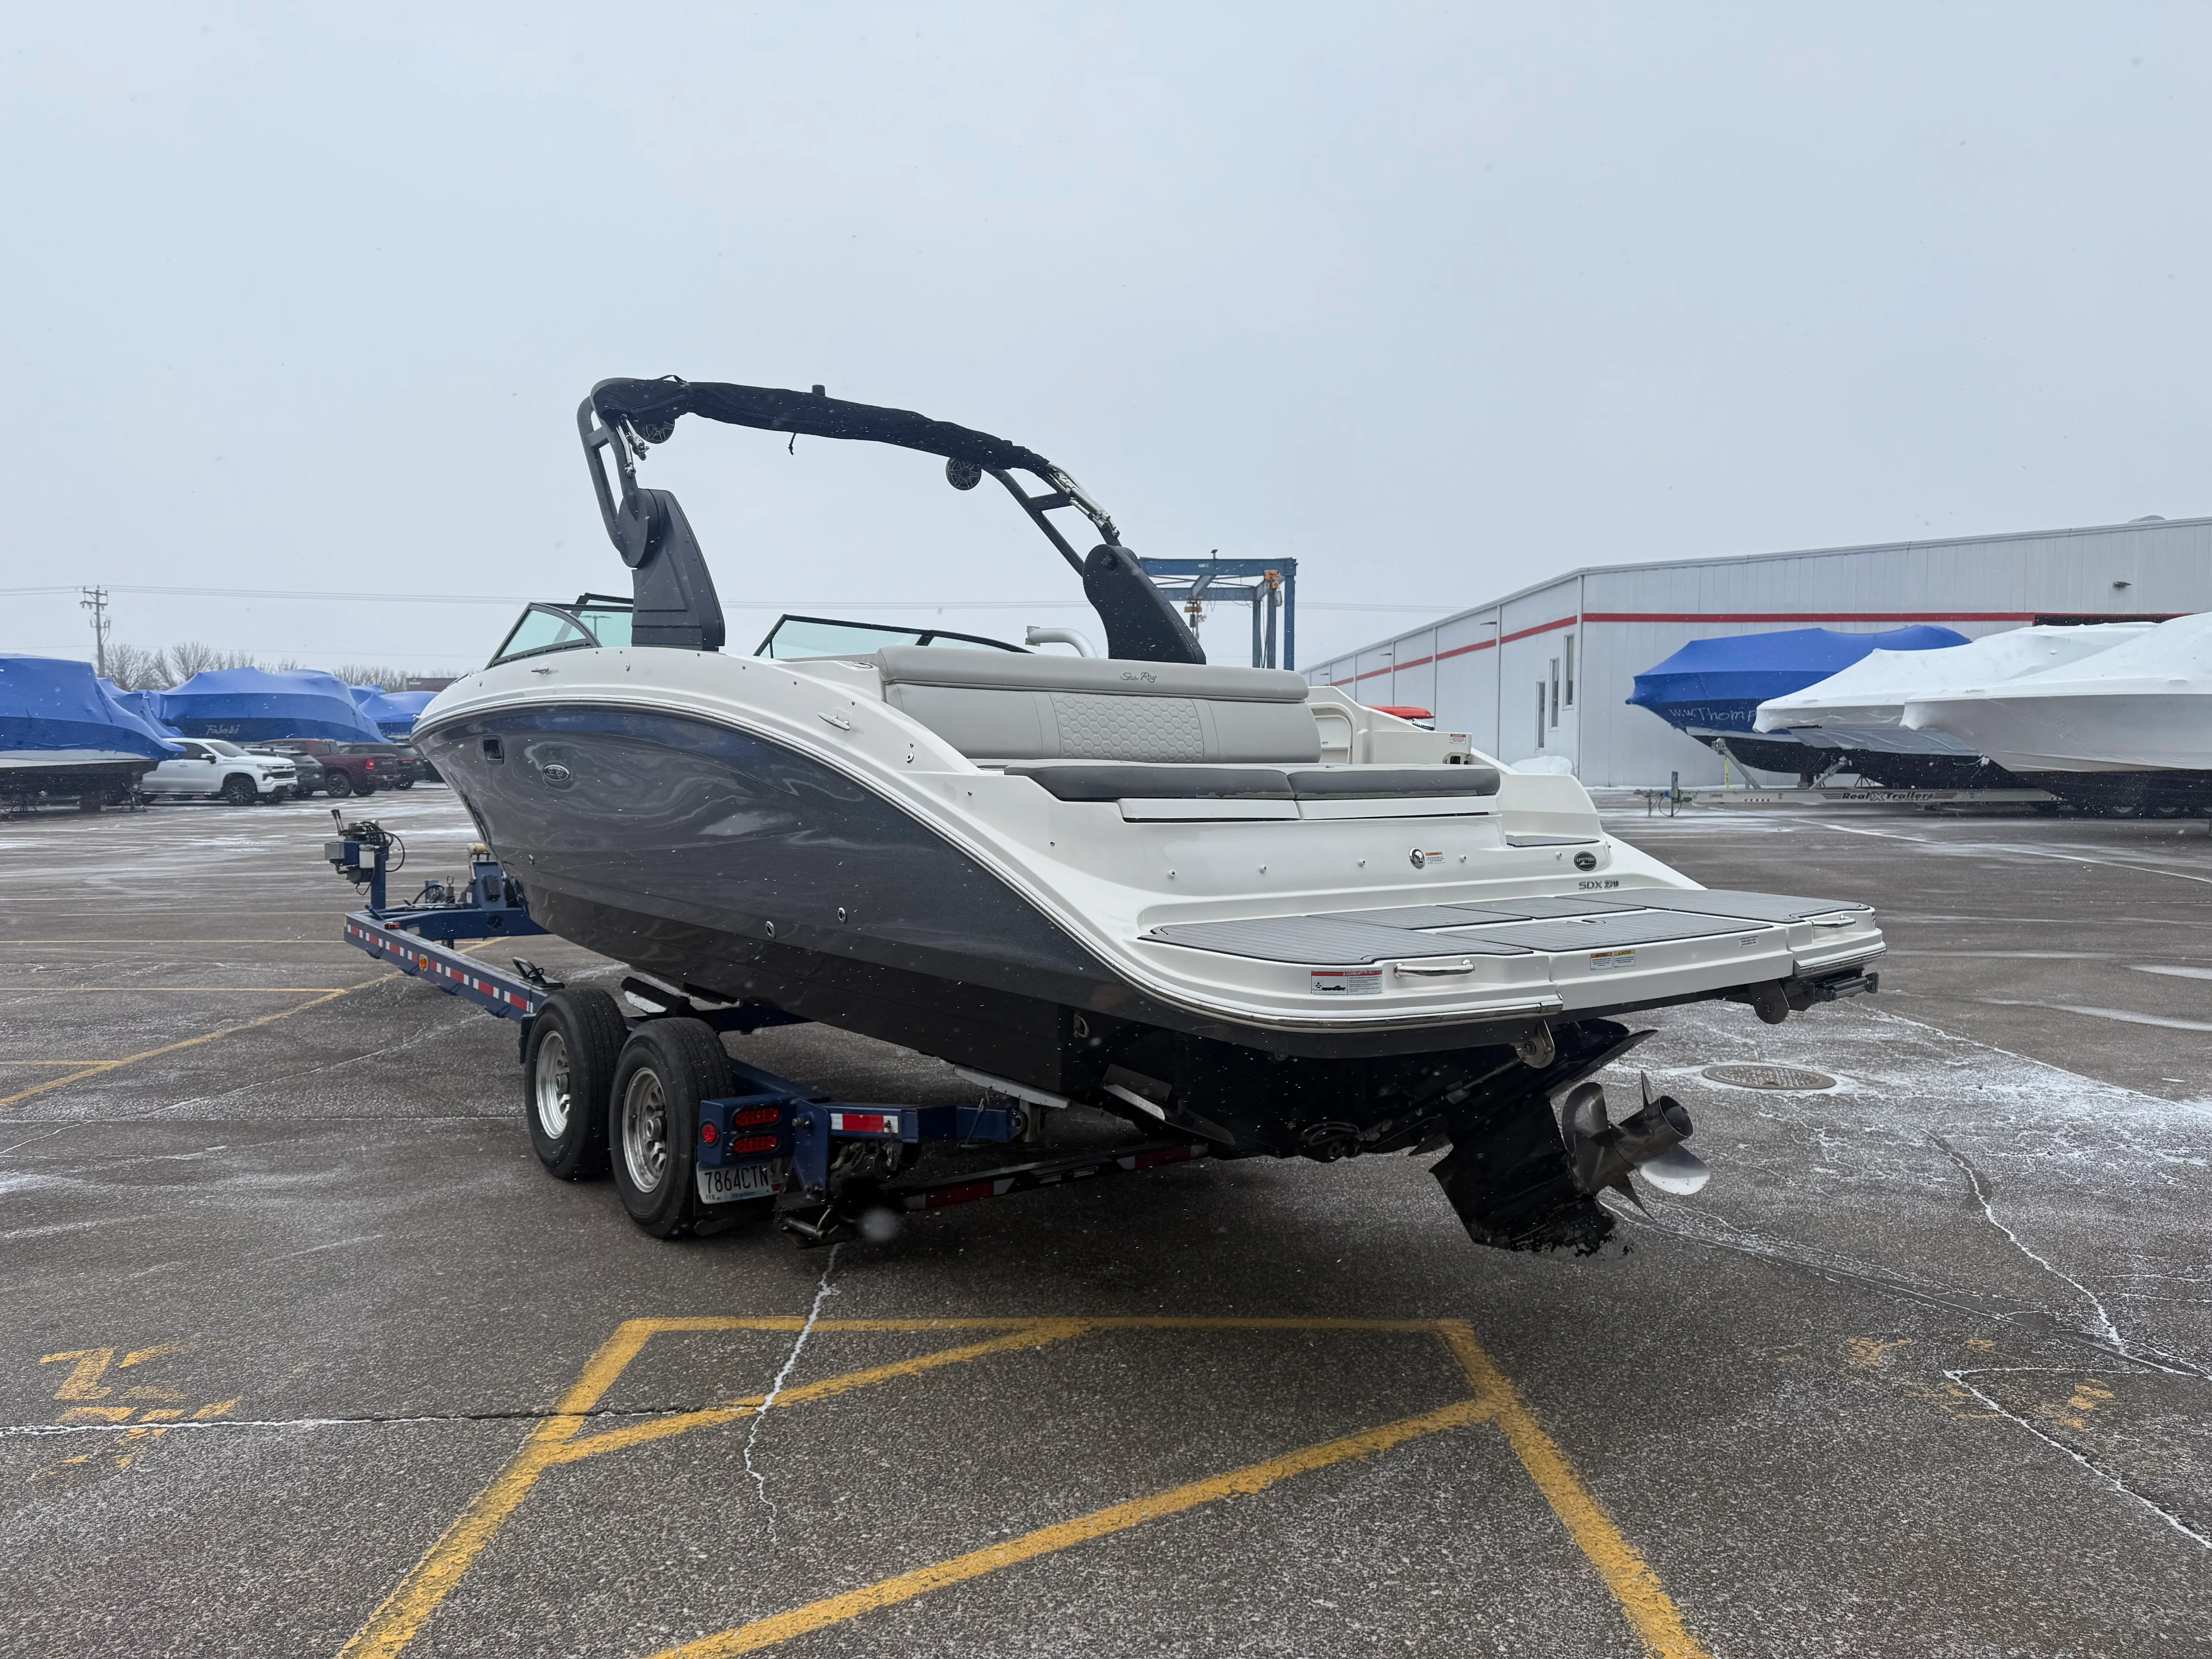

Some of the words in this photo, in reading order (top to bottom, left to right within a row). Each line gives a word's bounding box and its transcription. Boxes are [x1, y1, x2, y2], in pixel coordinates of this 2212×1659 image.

[1120, 672, 1139, 681] Sea
[1141, 672, 1157, 683] Ray
[1578, 880, 1602, 890] SDX
[704, 1164, 769, 1194] 7864CTN
